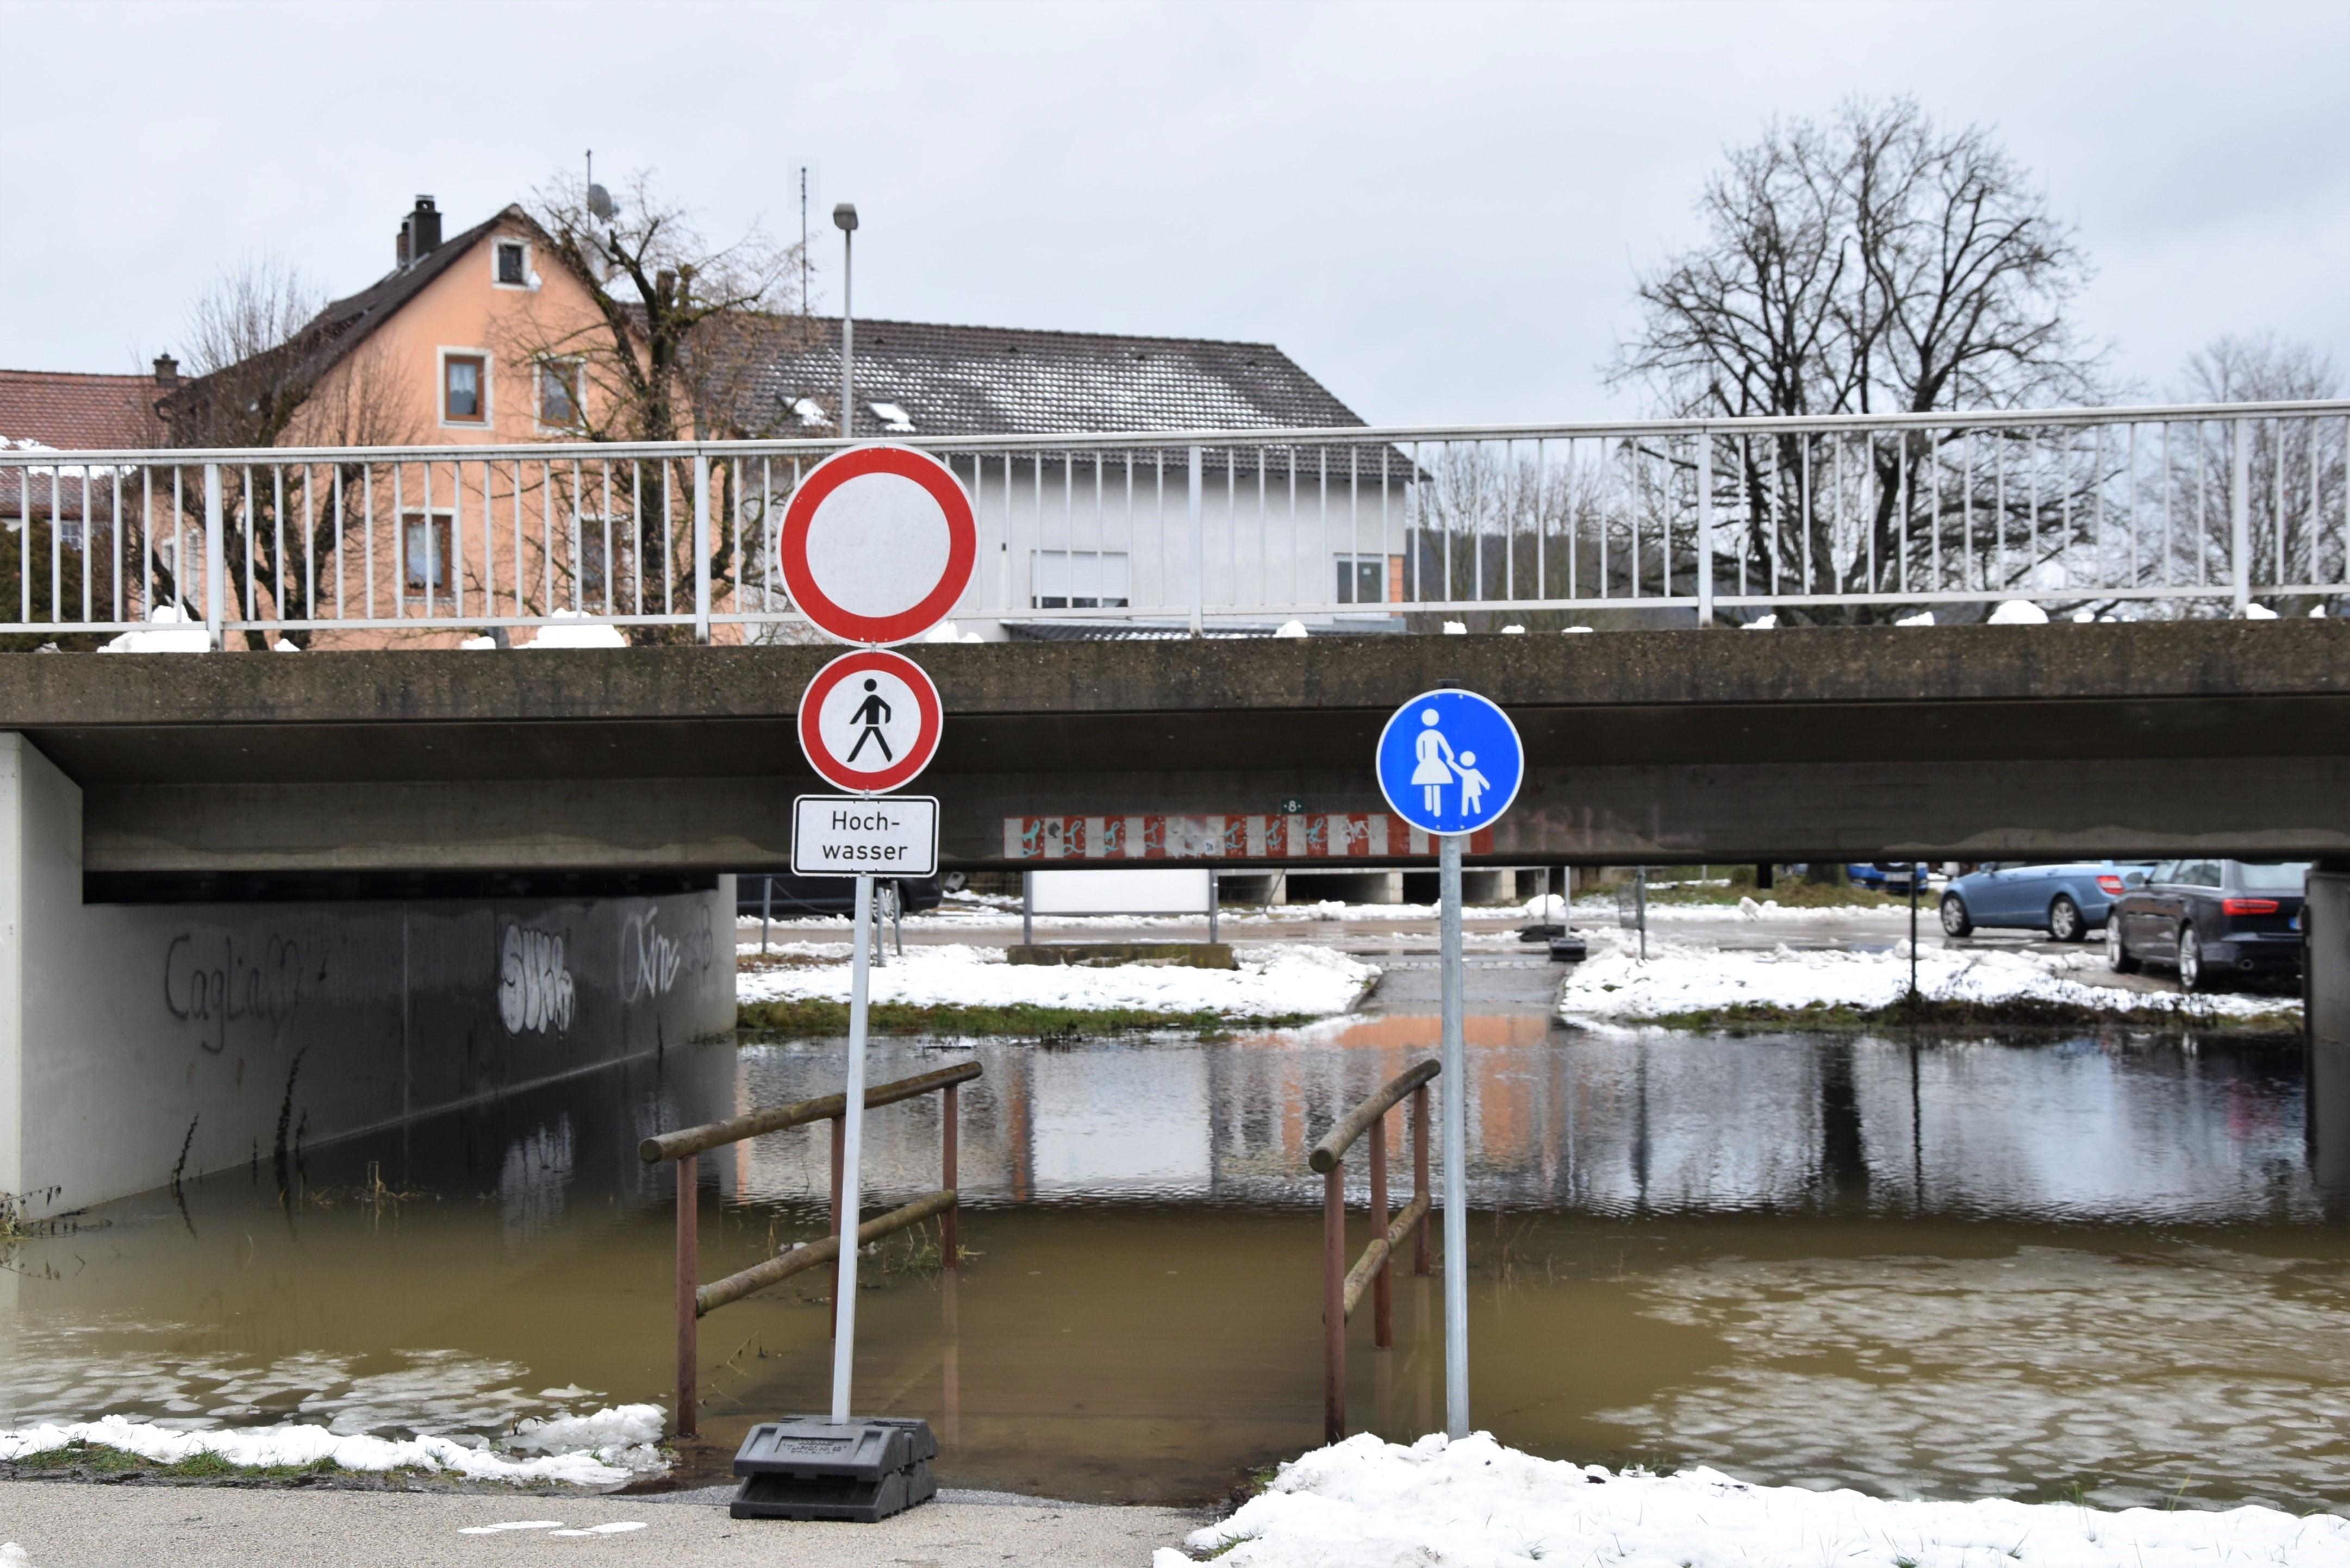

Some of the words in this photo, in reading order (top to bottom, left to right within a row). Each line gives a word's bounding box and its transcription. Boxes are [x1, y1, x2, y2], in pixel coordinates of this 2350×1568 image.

[1288, 800, 1297, 812] 8
[832, 810, 900, 830] Hoch-
[822, 845, 908, 860] wasser
